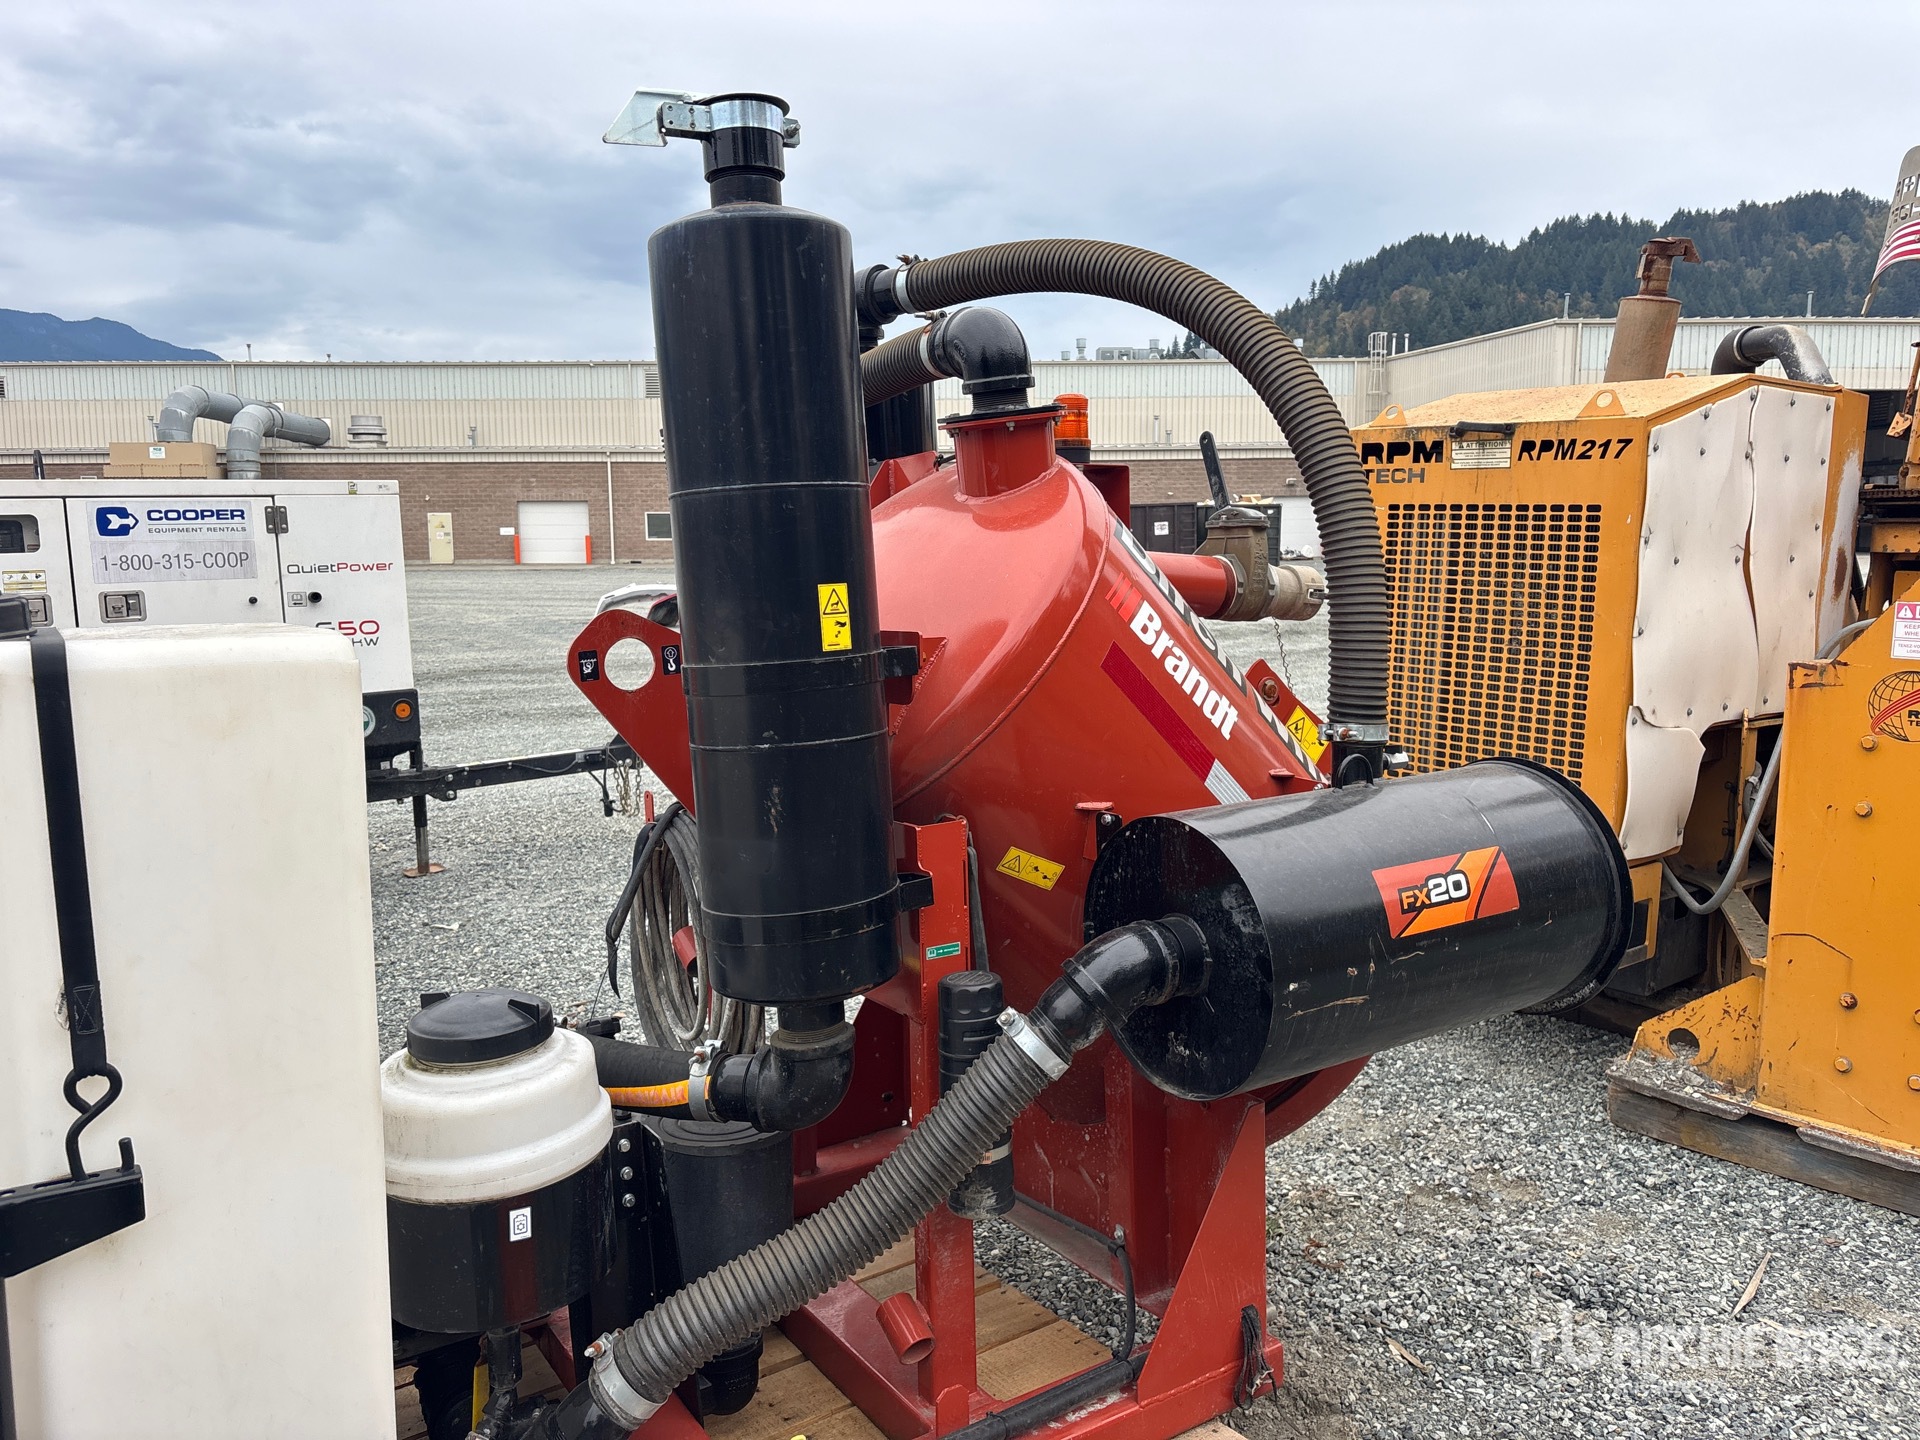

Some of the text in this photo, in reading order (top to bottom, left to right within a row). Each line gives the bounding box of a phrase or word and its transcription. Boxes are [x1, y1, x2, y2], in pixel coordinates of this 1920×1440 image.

[1361, 440, 1444, 465] RPM
[1517, 437, 1633, 462] RPM217
[146, 508, 246, 522] COOPER
[100, 551, 249, 572] 1-800-315-COOP
[286, 562, 394, 575] QuietPower
[1129, 600, 1239, 741] Brandt
[1401, 873, 1468, 910] FX20
